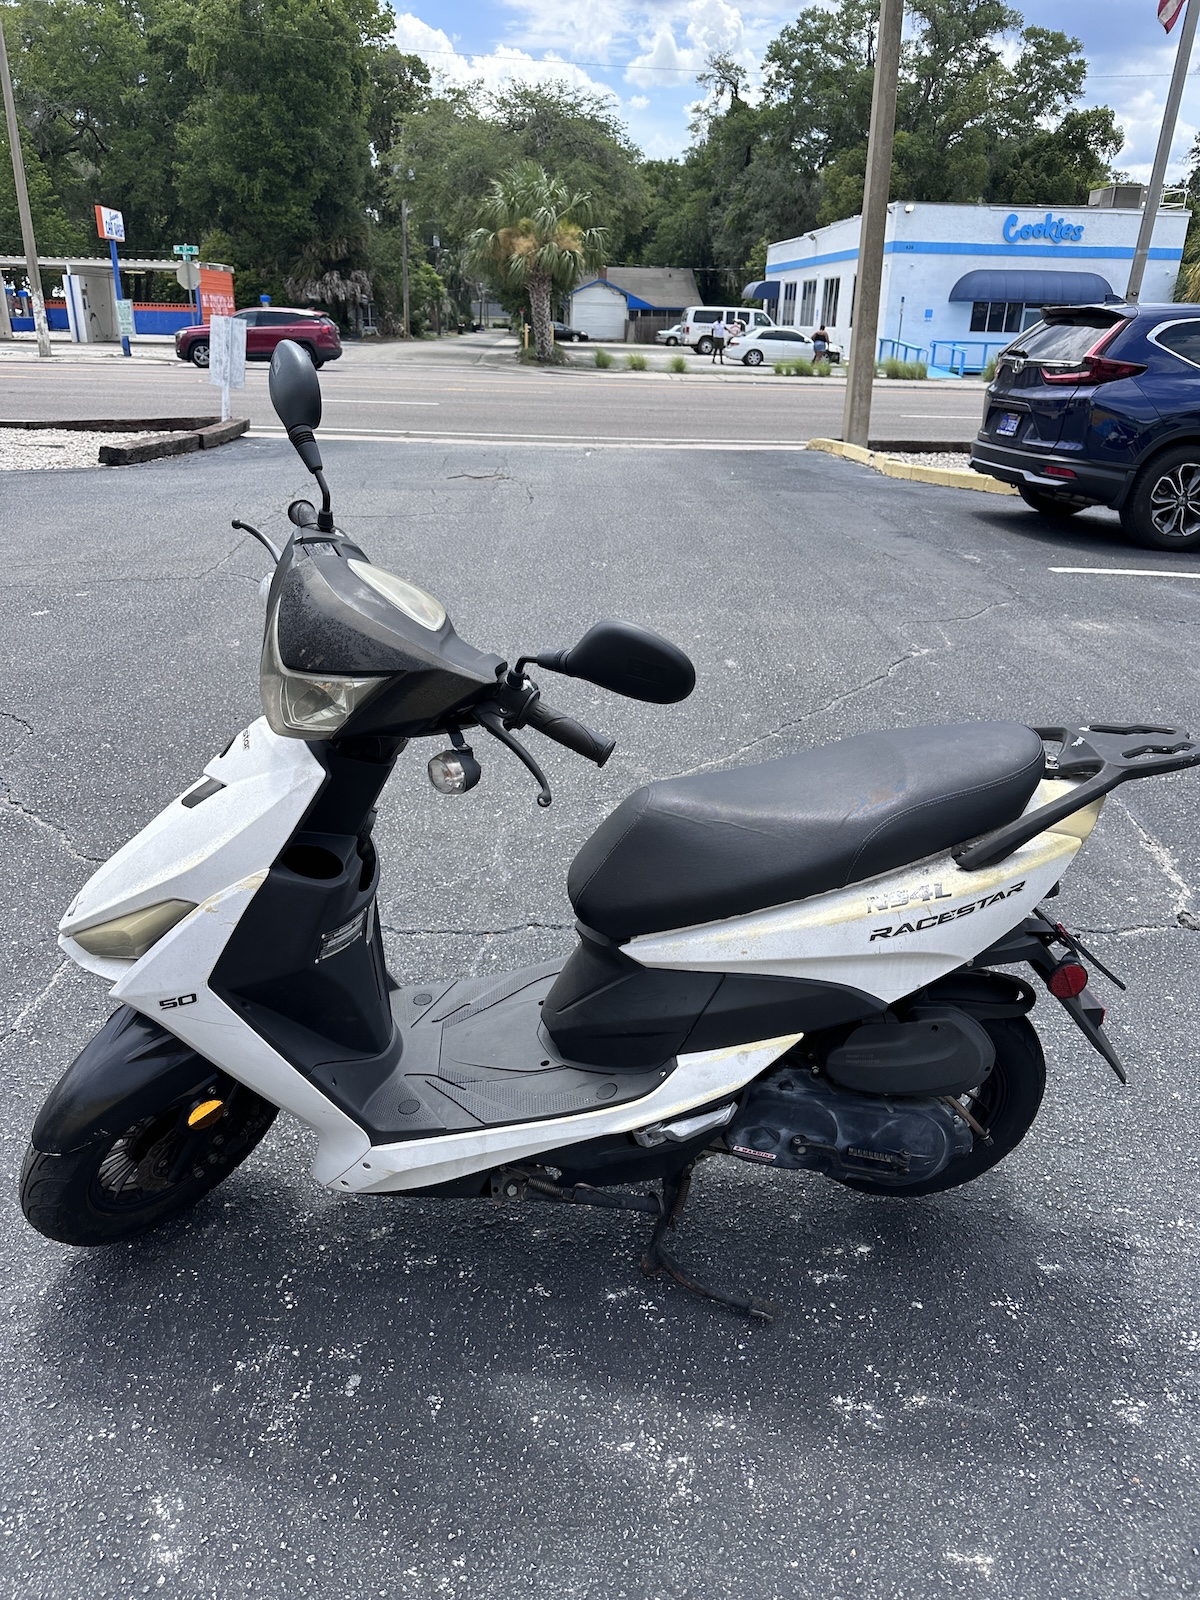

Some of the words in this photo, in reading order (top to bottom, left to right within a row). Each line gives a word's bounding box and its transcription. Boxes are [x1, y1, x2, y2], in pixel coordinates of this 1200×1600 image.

[1003, 212, 1085, 244] Cookies
[869, 880, 1026, 941] RACESTAR
[159, 993, 197, 1010] 50
